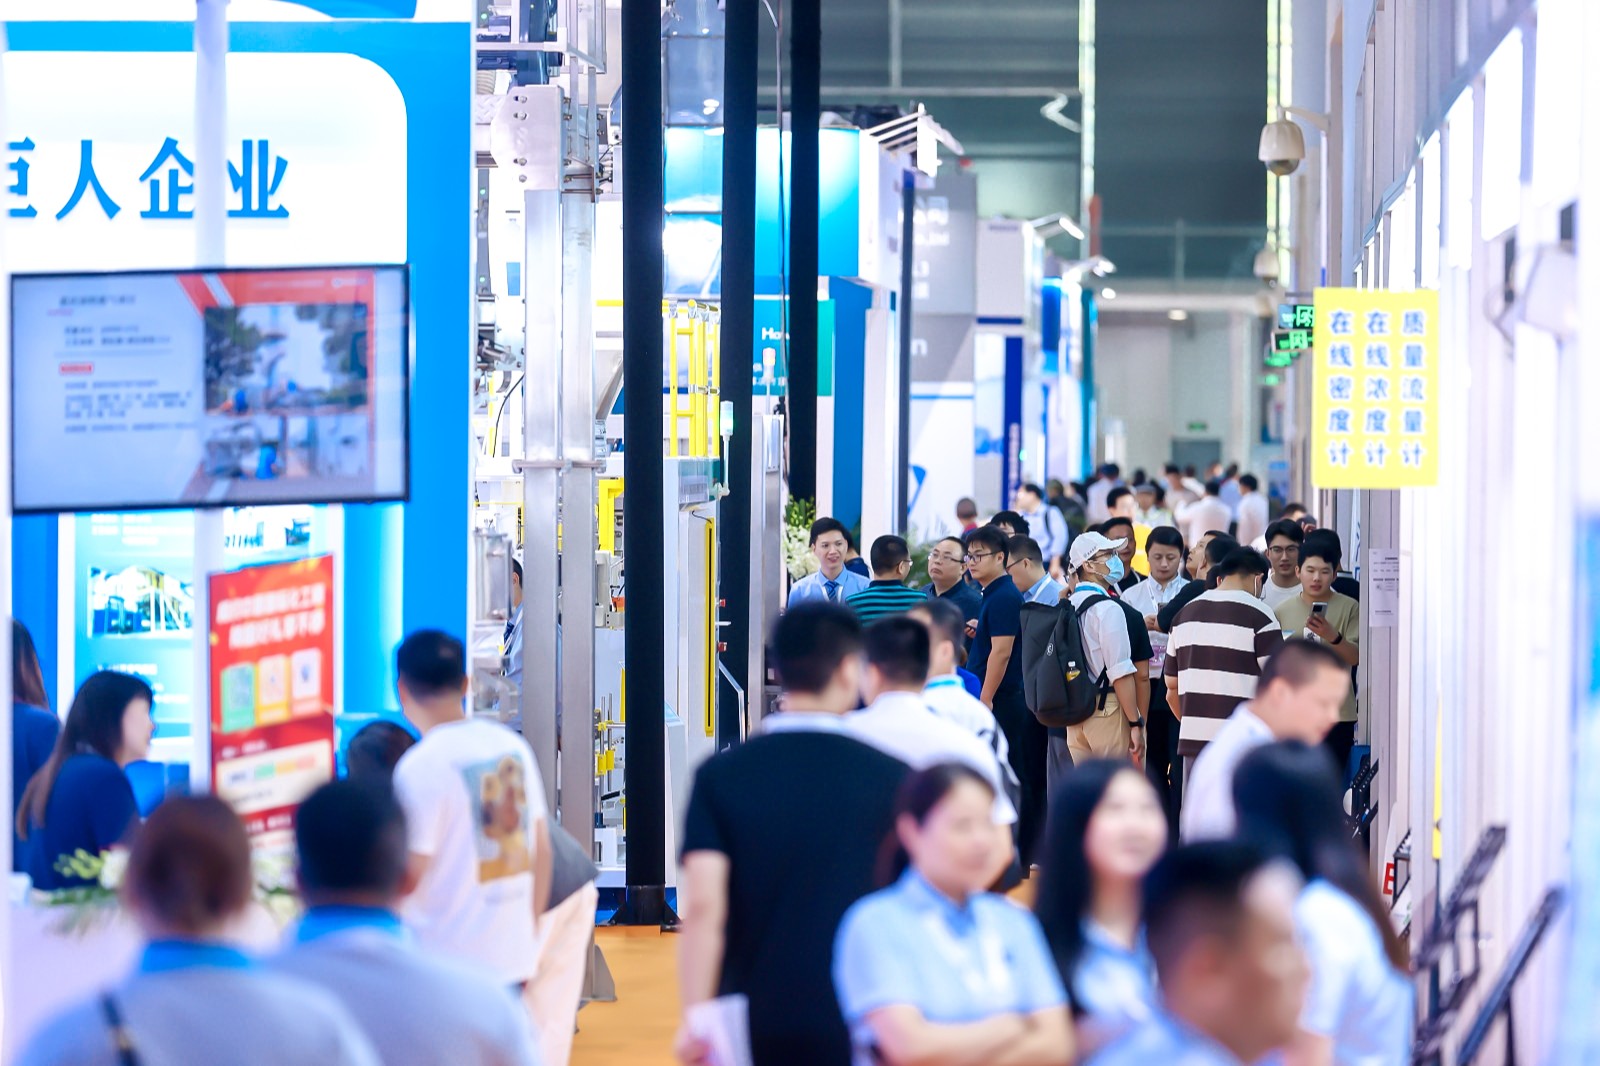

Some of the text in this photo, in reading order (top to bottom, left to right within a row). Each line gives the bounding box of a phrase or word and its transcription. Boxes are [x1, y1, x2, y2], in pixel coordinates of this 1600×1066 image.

[1328, 310, 1353, 466] 在线密度计
[1365, 310, 1389, 466] 在线浓度计
[1402, 310, 1425, 466] 质量流量计
